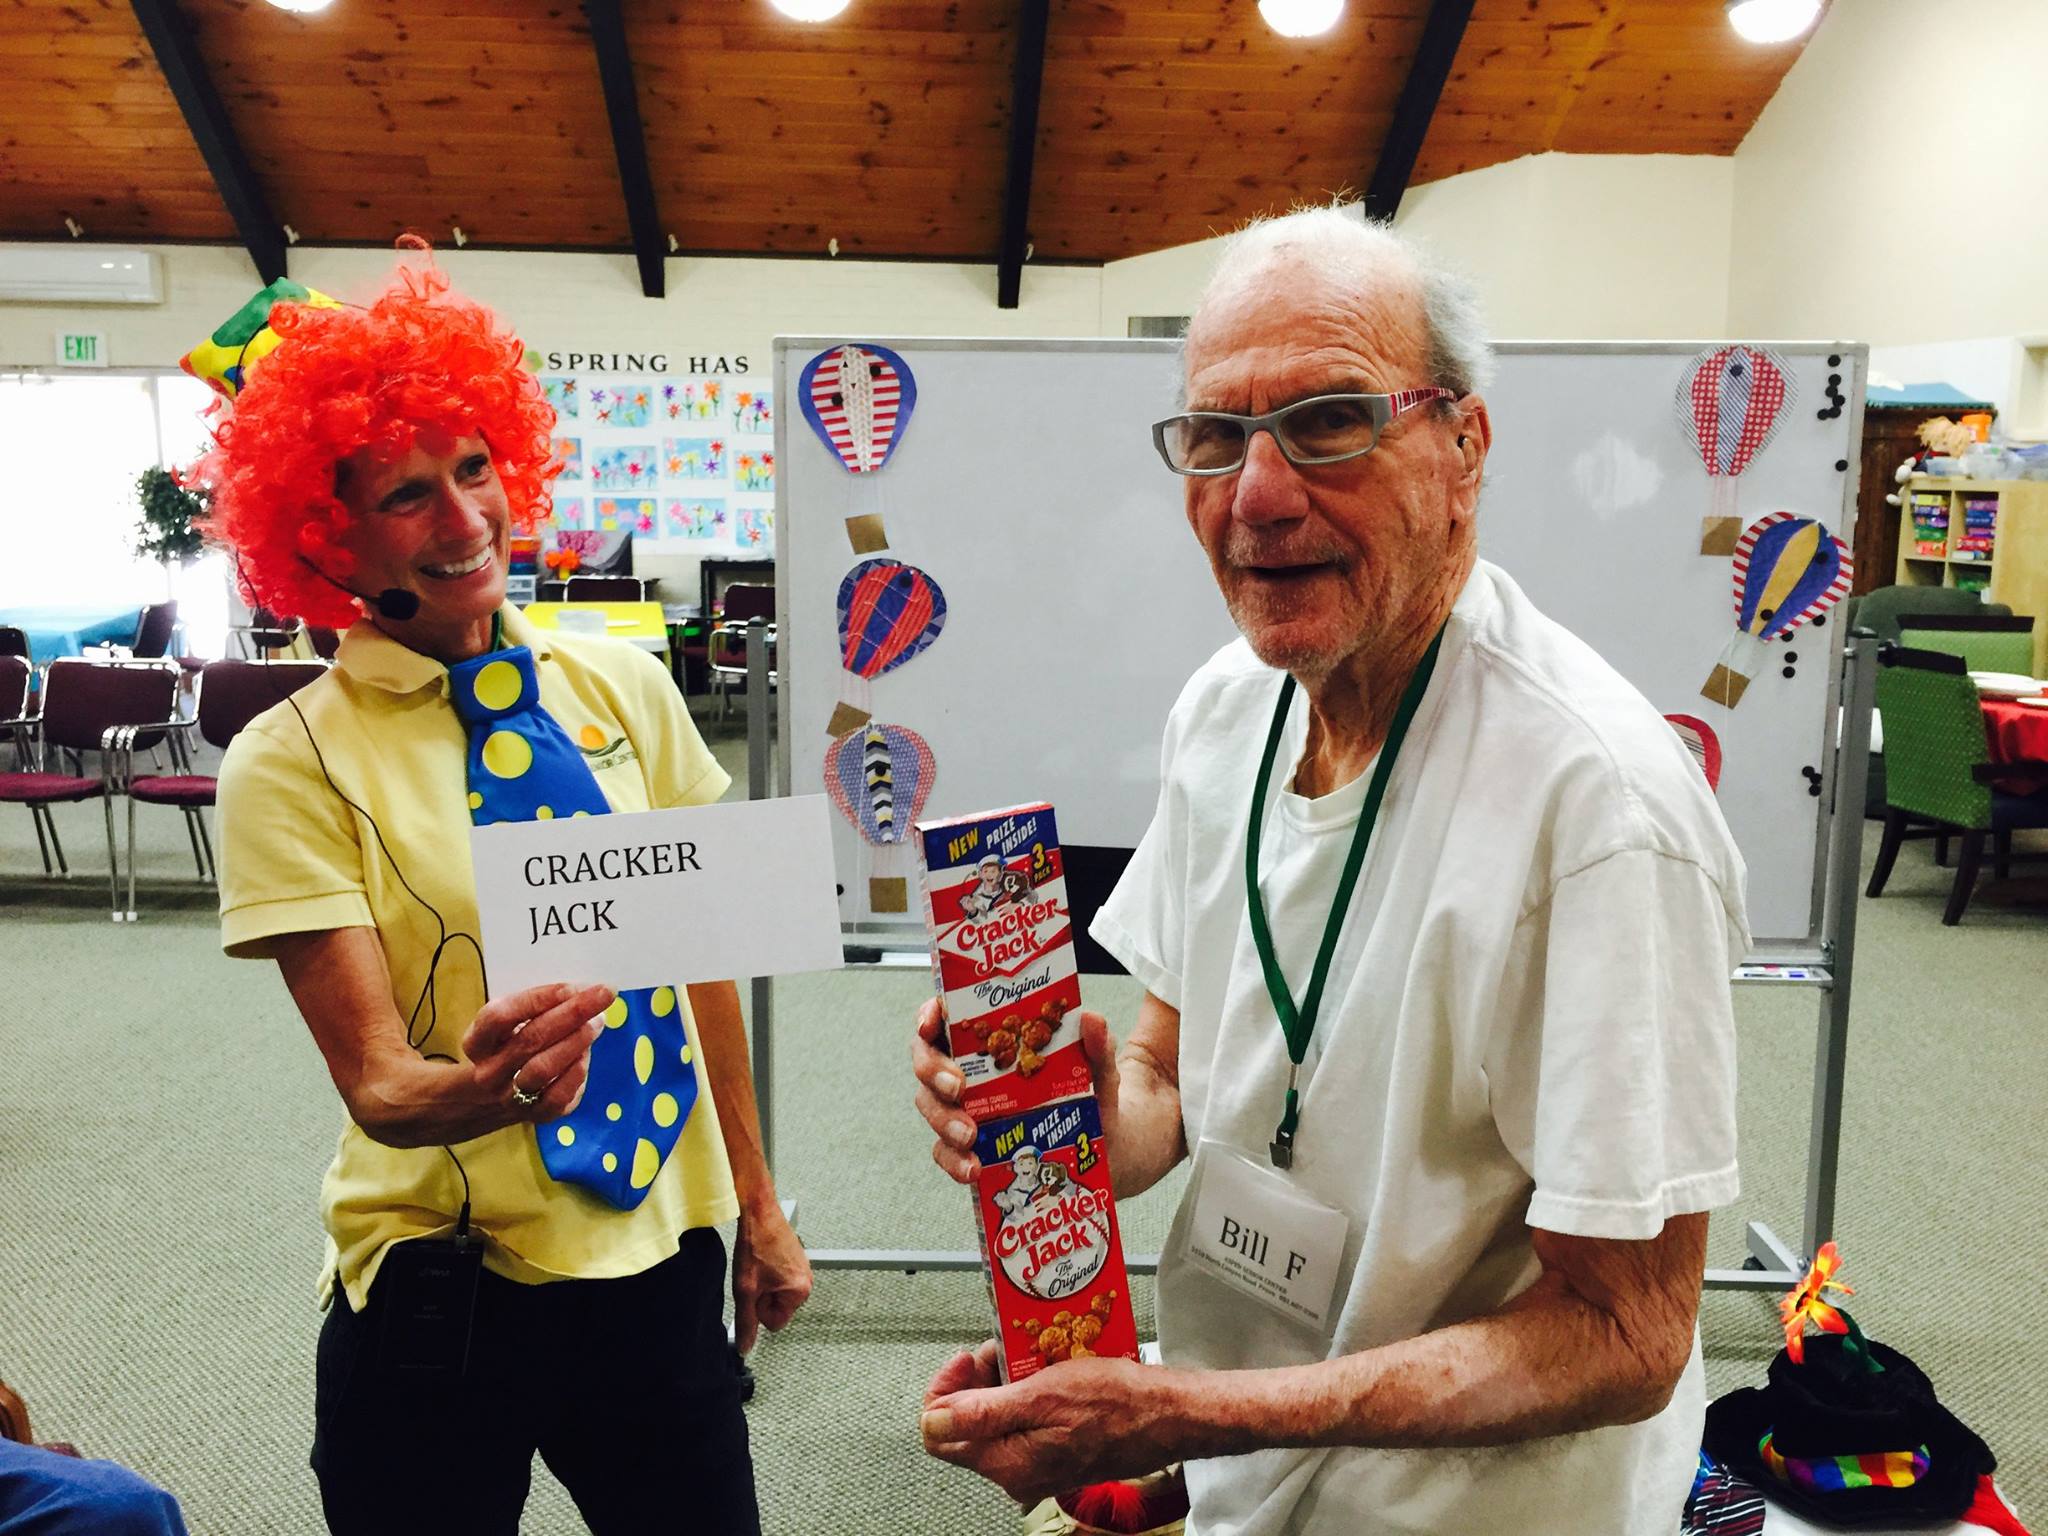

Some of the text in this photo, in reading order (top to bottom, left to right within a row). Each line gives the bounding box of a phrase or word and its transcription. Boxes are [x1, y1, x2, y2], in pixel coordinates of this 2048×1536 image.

[64, 336, 97, 361] EXIT
[547, 352, 750, 374] SPRING HAS
[948, 816, 1016, 863] NEW PRIZE
[1001, 816, 1037, 856] INSIDE!
[1031, 841, 1046, 870] 3
[524, 841, 702, 887] CRACKER
[1033, 867, 1051, 883] PACK
[529, 899, 619, 945] JACK
[956, 897, 1058, 951] Cracker
[975, 929, 1041, 977] Jack
[974, 966, 1052, 1008] The Original
[995, 1108, 1060, 1158] NEW PRIZE
[1047, 1107, 1081, 1148] INSIDE!
[1076, 1132, 1091, 1160] 3
[1079, 1155, 1097, 1174] PACK
[994, 1188, 1109, 1258] Cracker
[1022, 1224, 1093, 1281] Jack
[1055, 1259, 1074, 1275] The
[1219, 1215, 1307, 1280] Bill F
[1048, 1253, 1099, 1298] Original
